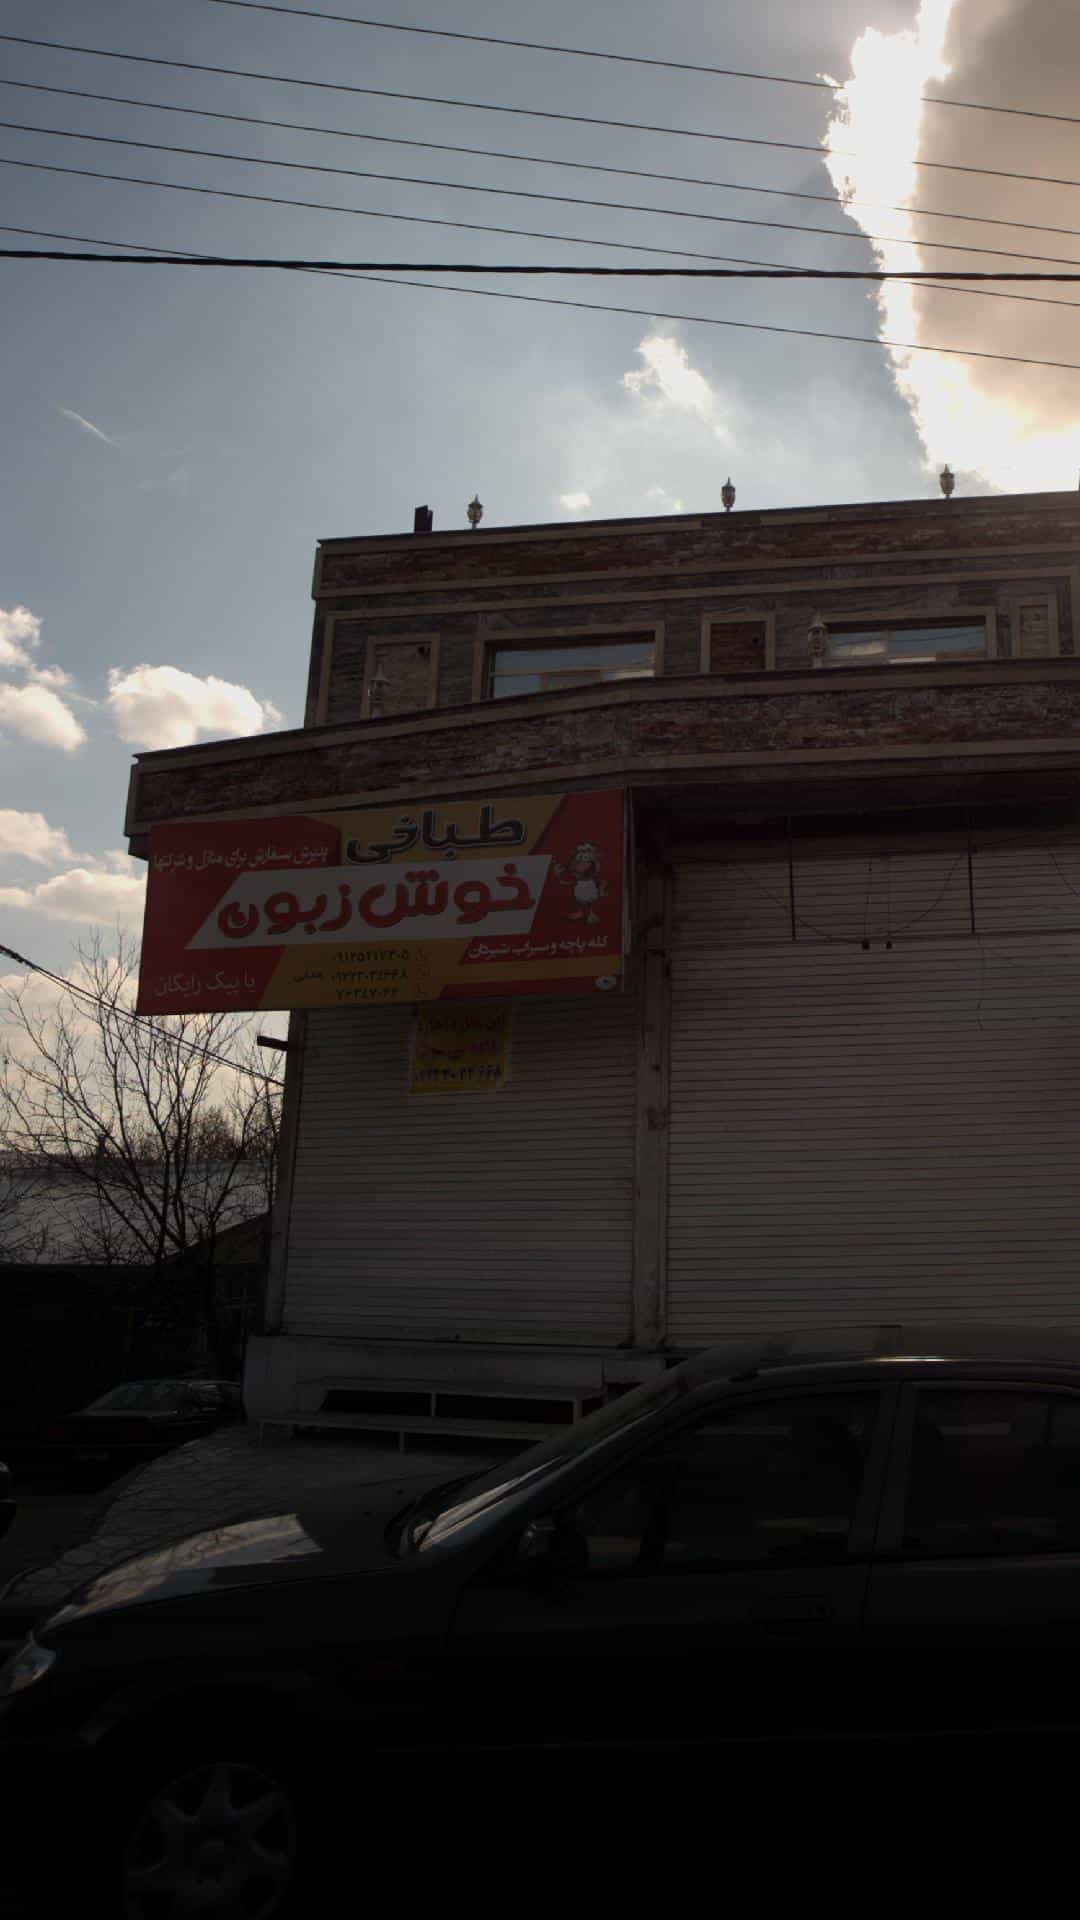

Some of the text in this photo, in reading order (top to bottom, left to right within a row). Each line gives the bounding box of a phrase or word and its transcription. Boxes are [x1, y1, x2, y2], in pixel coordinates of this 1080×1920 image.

[347, 803, 526, 864] طباخی
[224, 848, 247, 869] برای
[248, 841, 292, 868] سفارش
[217, 863, 537, 939] خوش زبون
[559, 936, 586, 954] پاچه
[587, 935, 608, 948] کله
[153, 971, 201, 998] رایگان
[207, 970, 241, 997] پیک
[244, 968, 256, 993] با
